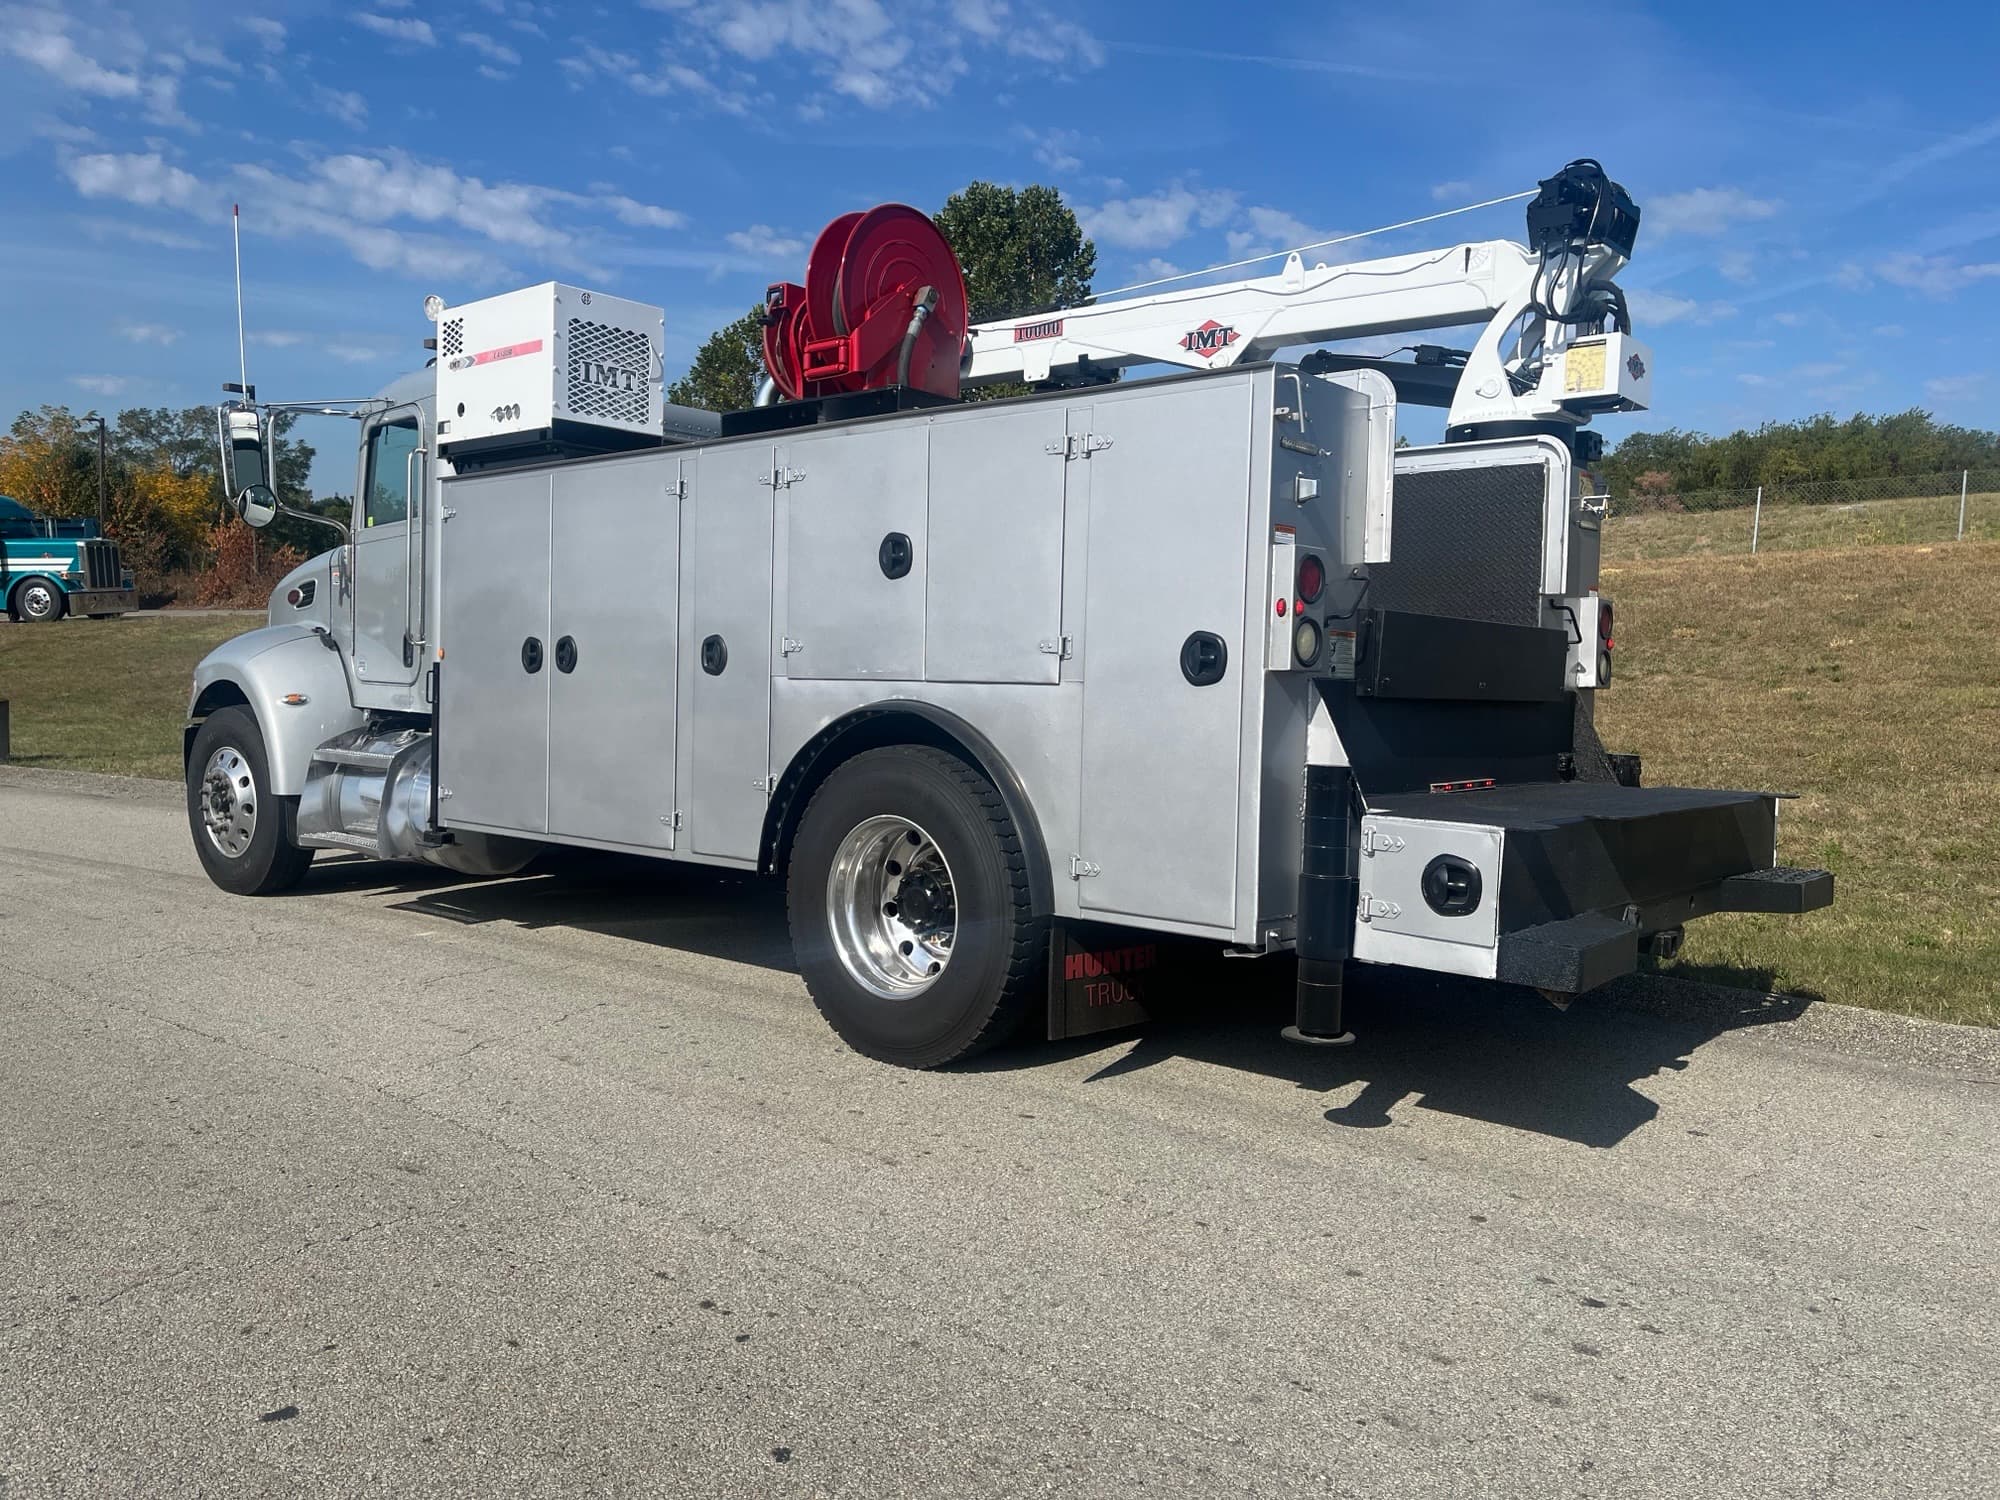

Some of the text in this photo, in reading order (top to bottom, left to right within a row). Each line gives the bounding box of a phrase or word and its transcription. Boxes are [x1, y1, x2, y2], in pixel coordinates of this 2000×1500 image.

[1017, 320, 1061, 341] 10000
[1185, 327, 1235, 352] IMT
[582, 361, 637, 392] IMT
[1066, 944, 1156, 980] HUNTER
[1085, 981, 1142, 1008] TRUC
